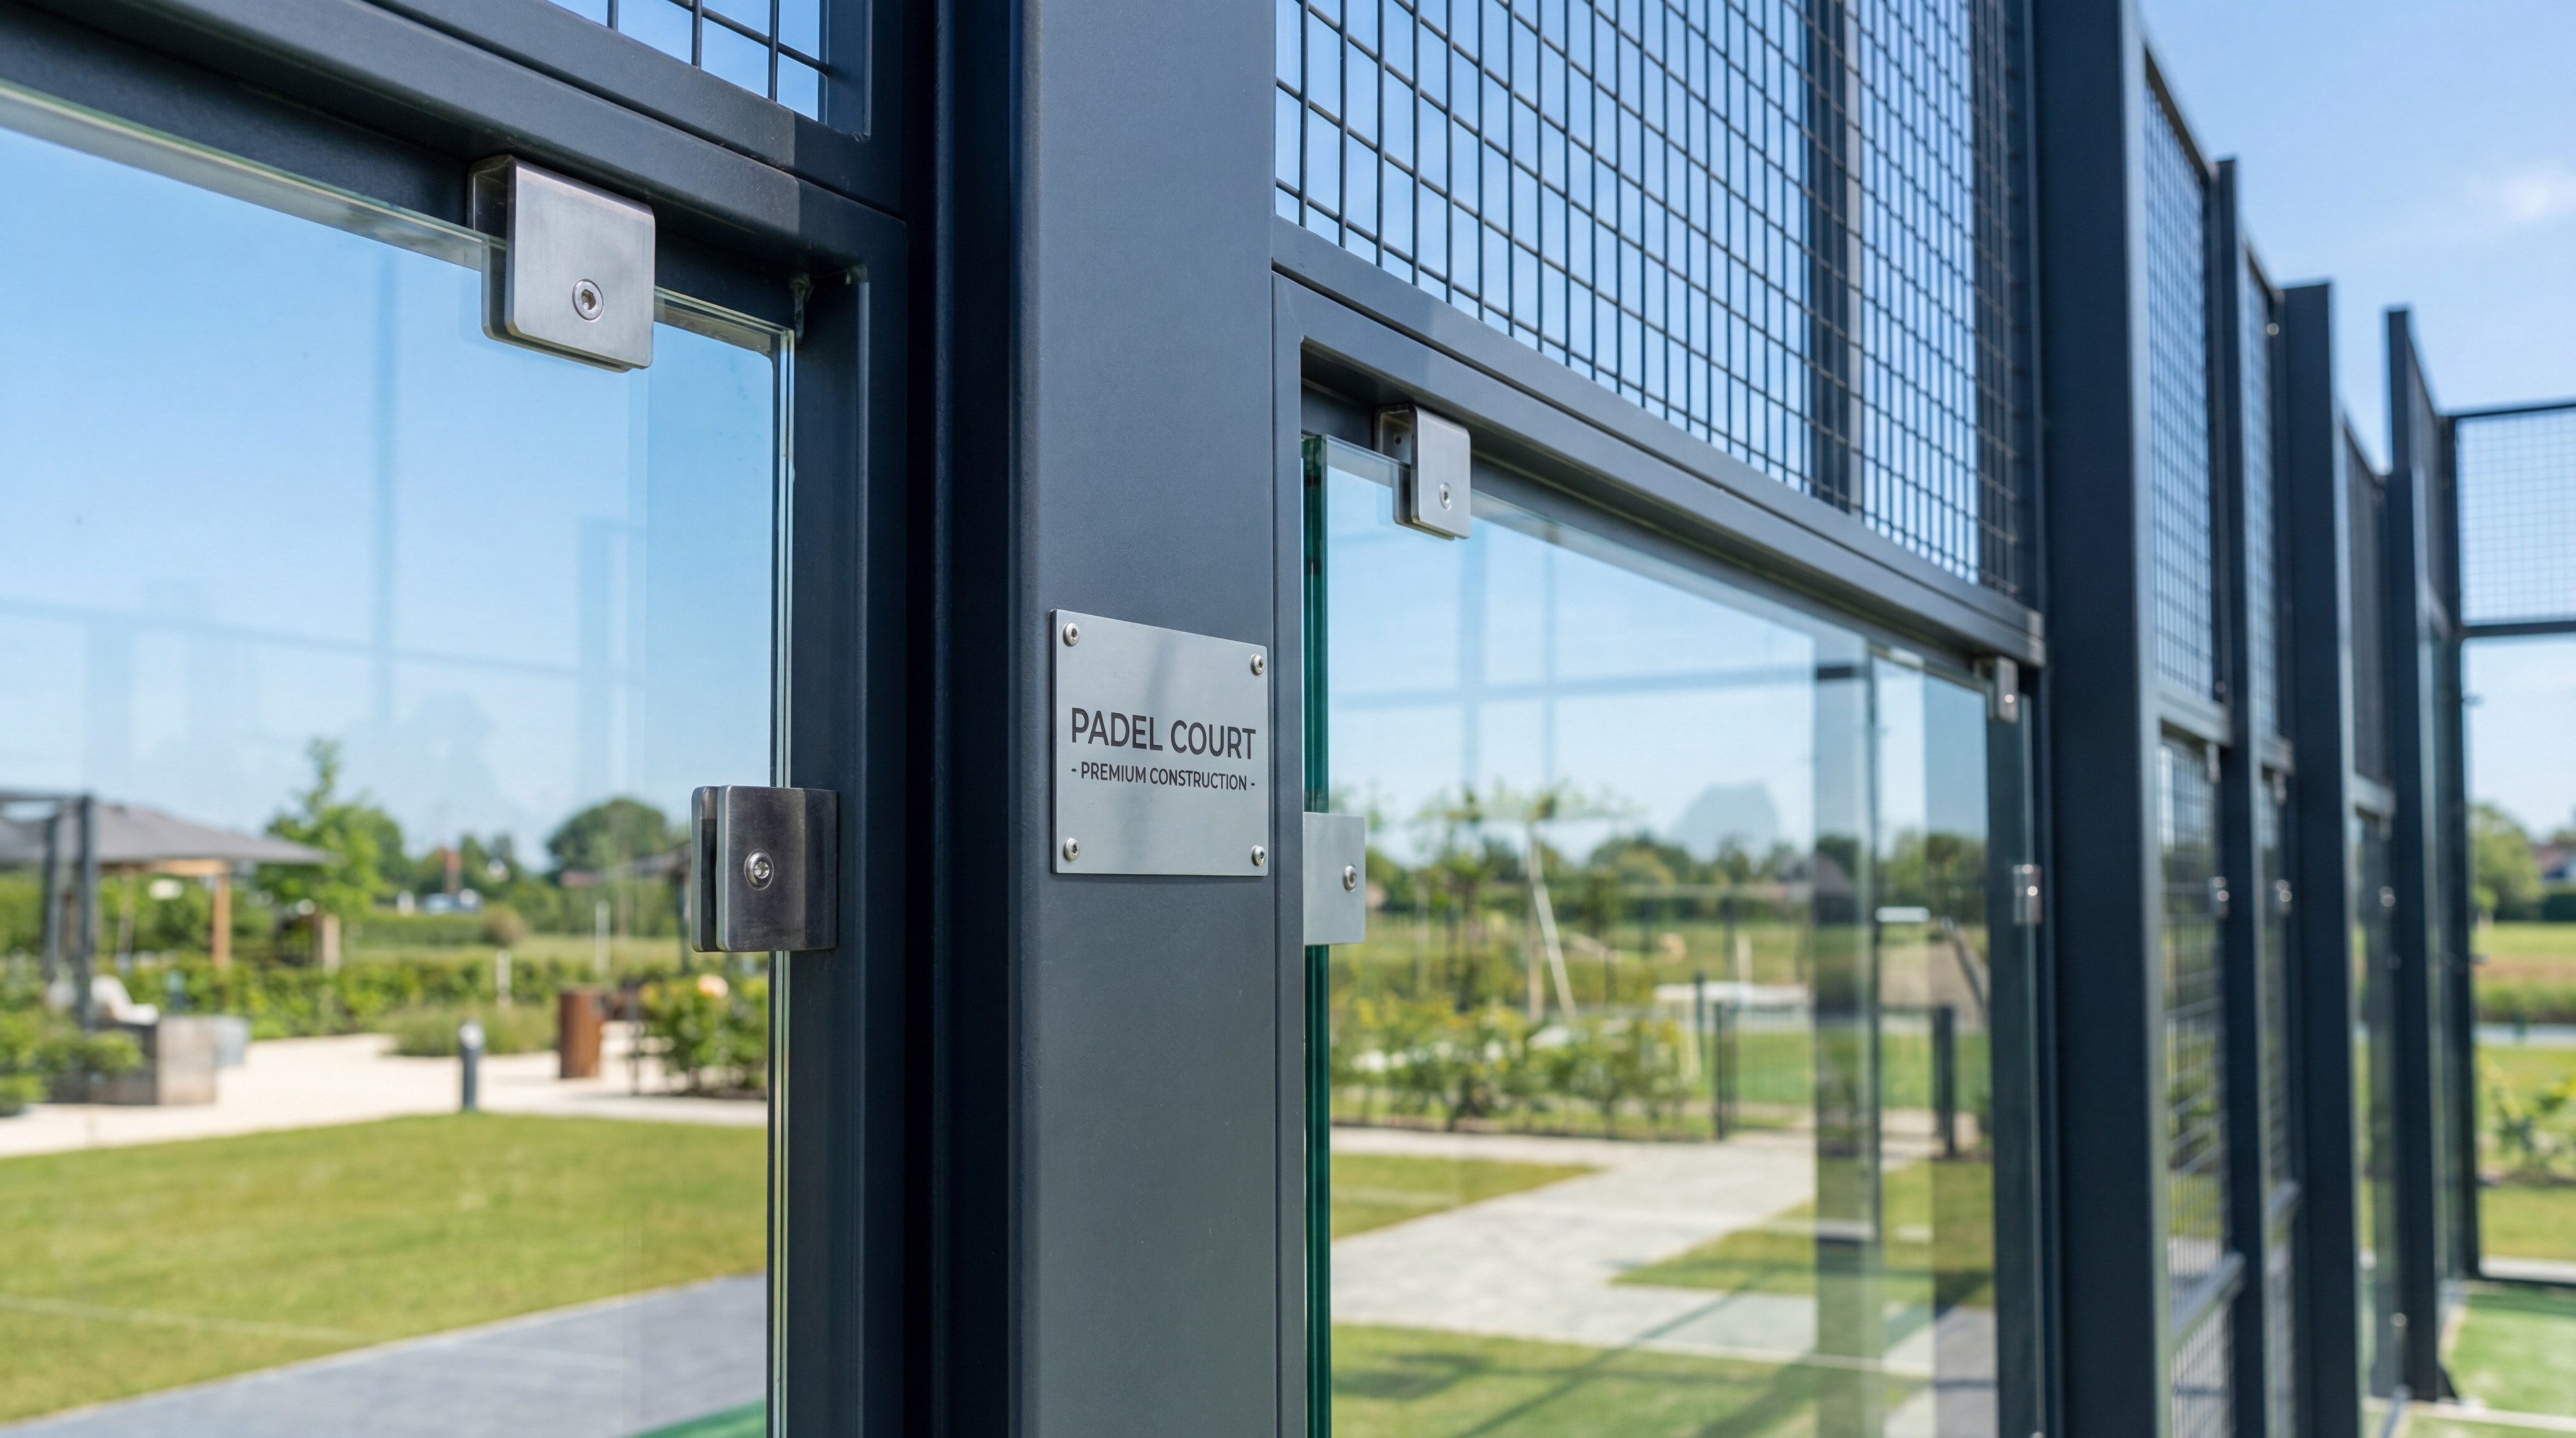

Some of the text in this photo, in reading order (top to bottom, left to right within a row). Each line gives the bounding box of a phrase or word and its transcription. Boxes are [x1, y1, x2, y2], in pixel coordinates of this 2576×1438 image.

[1071, 706, 1257, 761] PADEL COURT
[1080, 761, 1147, 784] PREMIUM
[1149, 767, 1247, 792] CONSTRUCTION
